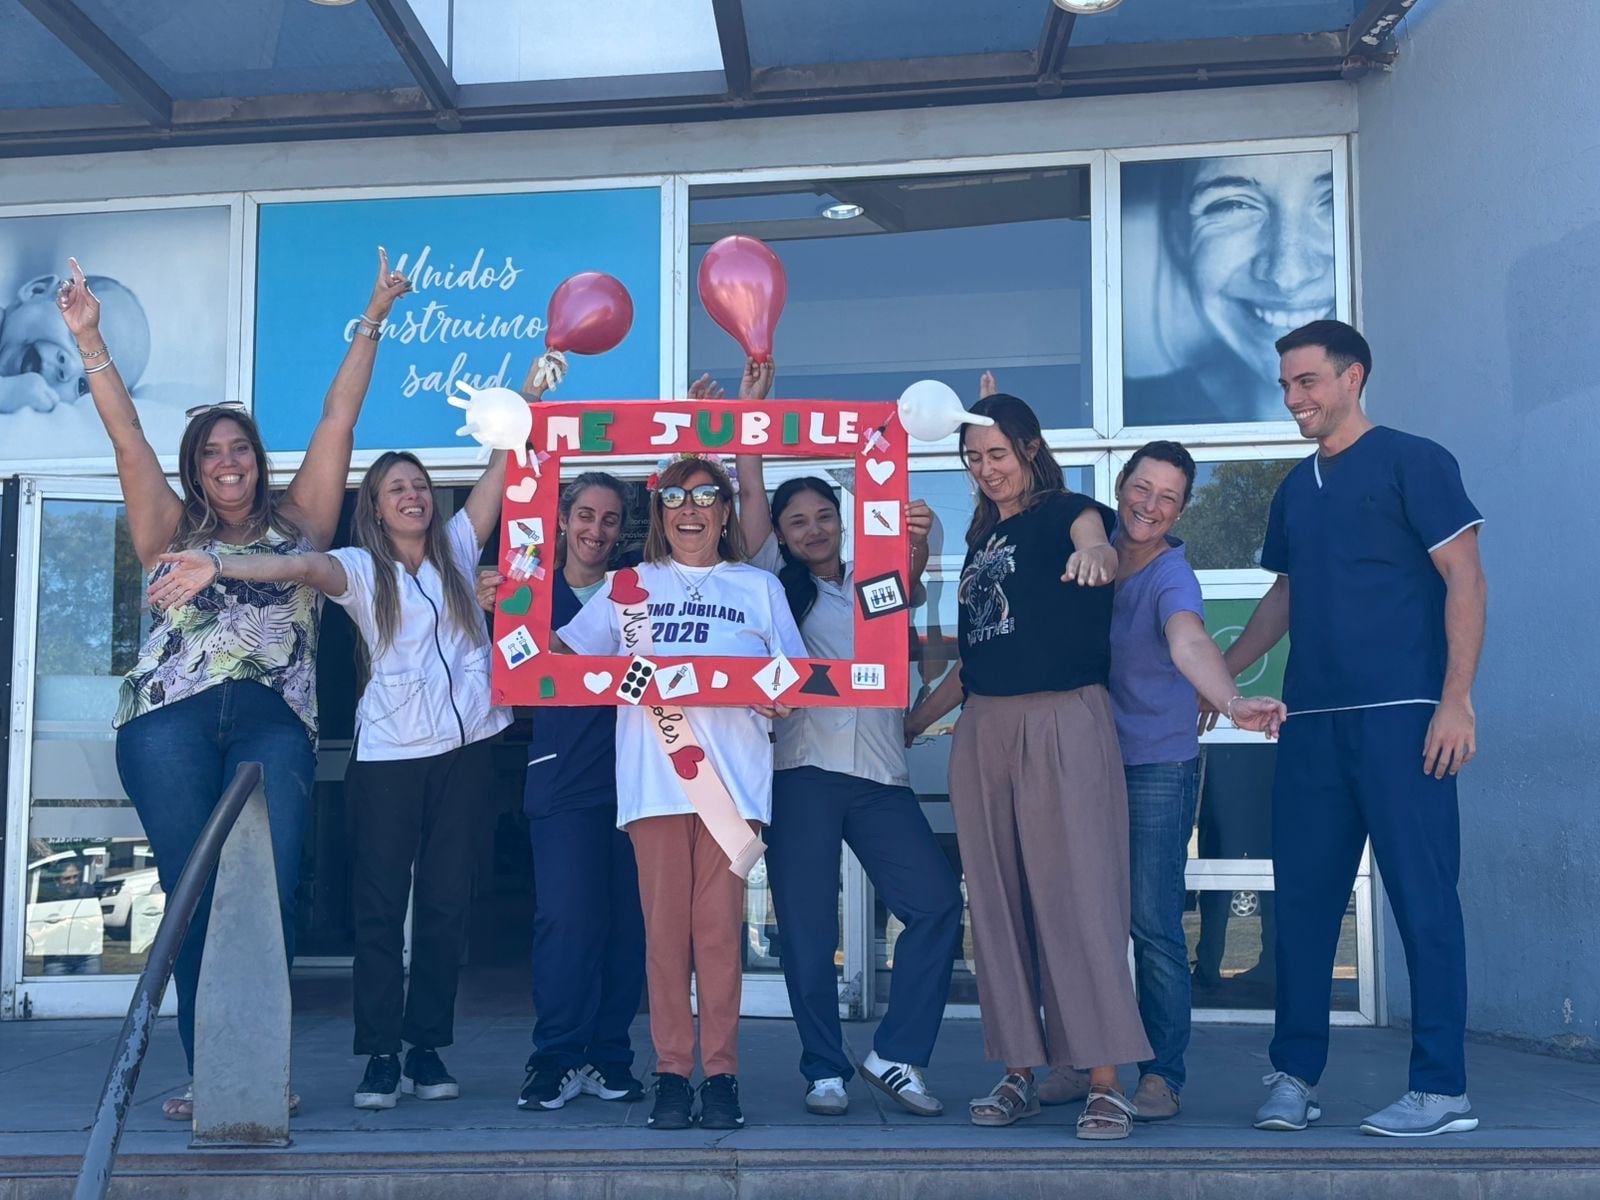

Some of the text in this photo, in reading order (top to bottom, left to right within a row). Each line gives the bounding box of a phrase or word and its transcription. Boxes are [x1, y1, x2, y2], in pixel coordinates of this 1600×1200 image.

[391, 245, 524, 294] Unidos
[343, 300, 547, 344] cnstruimo
[547, 409, 860, 452] ME JUBILE
[622, 608, 649, 648] Miss
[651, 621, 710, 644] 2026
[678, 601, 746, 625] JUBILADA
[649, 704, 683, 744] oles
